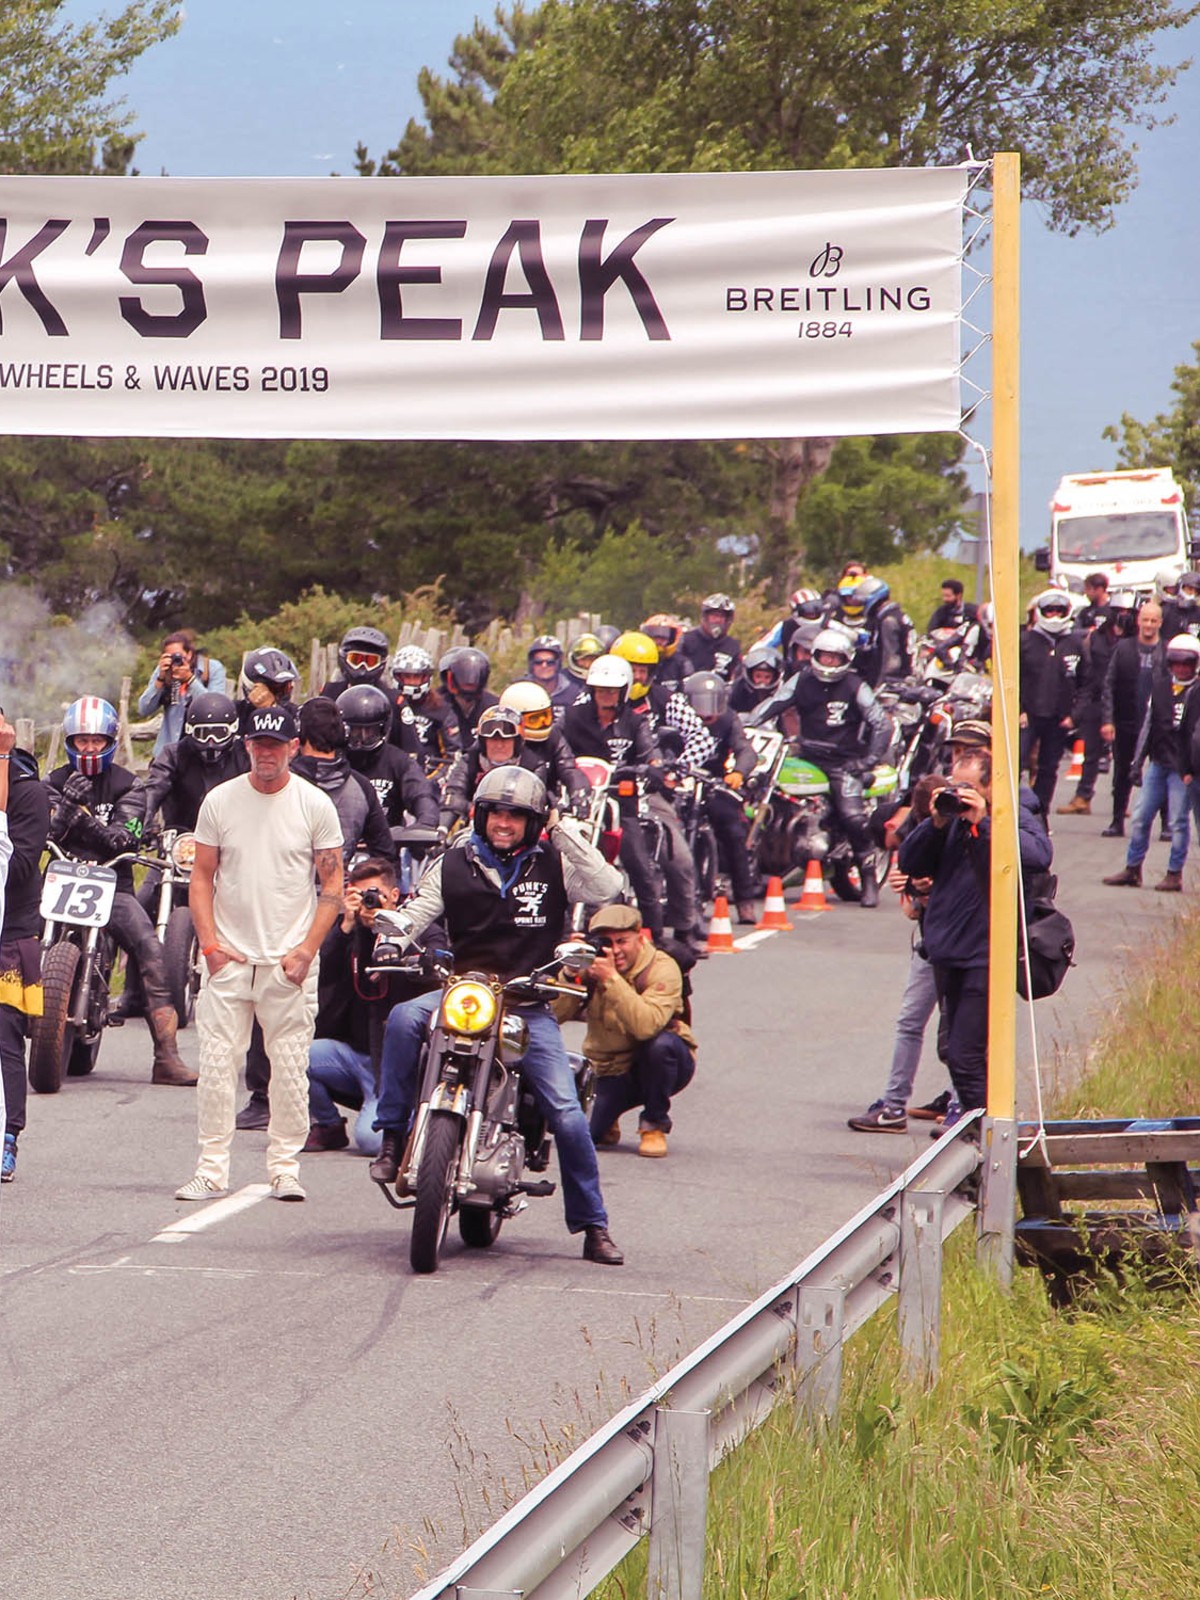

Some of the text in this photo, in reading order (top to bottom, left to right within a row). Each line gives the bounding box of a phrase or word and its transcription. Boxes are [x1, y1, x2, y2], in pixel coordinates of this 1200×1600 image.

[276, 218, 677, 341] PEAK
[726, 287, 931, 311] BREITLING
[798, 321, 853, 339] 1884
[124, 365, 141, 390] &
[154, 365, 250, 391] WAVES
[261, 367, 329, 392] 2019
[51, 882, 104, 919] 13
[512, 881, 548, 896] PUNK'S
